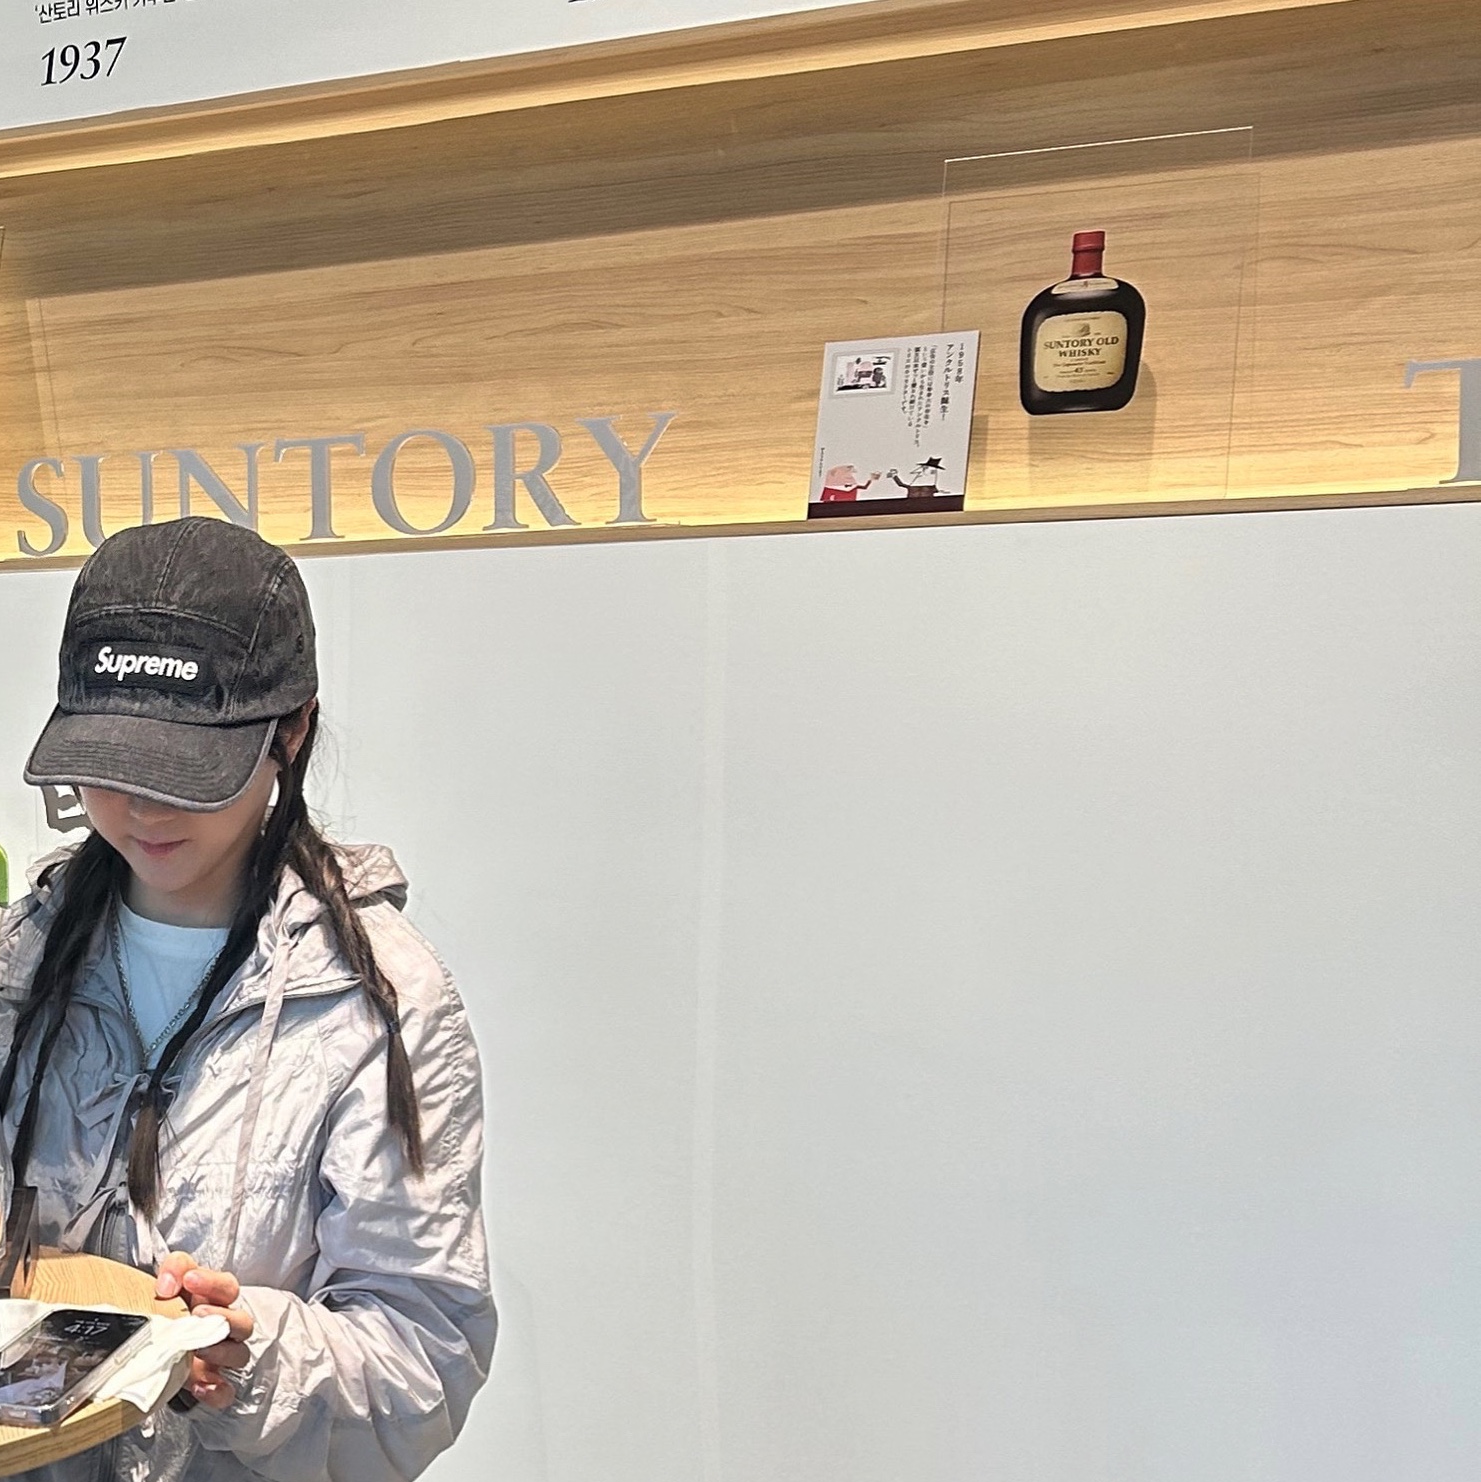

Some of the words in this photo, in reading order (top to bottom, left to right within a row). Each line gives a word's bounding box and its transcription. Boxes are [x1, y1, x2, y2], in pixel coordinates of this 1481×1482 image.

[41, 36, 127, 86] 1937
[1044, 338, 1094, 350] SUNTORY
[1096, 336, 1120, 346] OLD
[1058, 348, 1102, 358] WHISKY
[17, 412, 678, 557] SUNTORY
[94, 646, 199, 682] Supreme
[64, 1324, 108, 1336] 4:17
